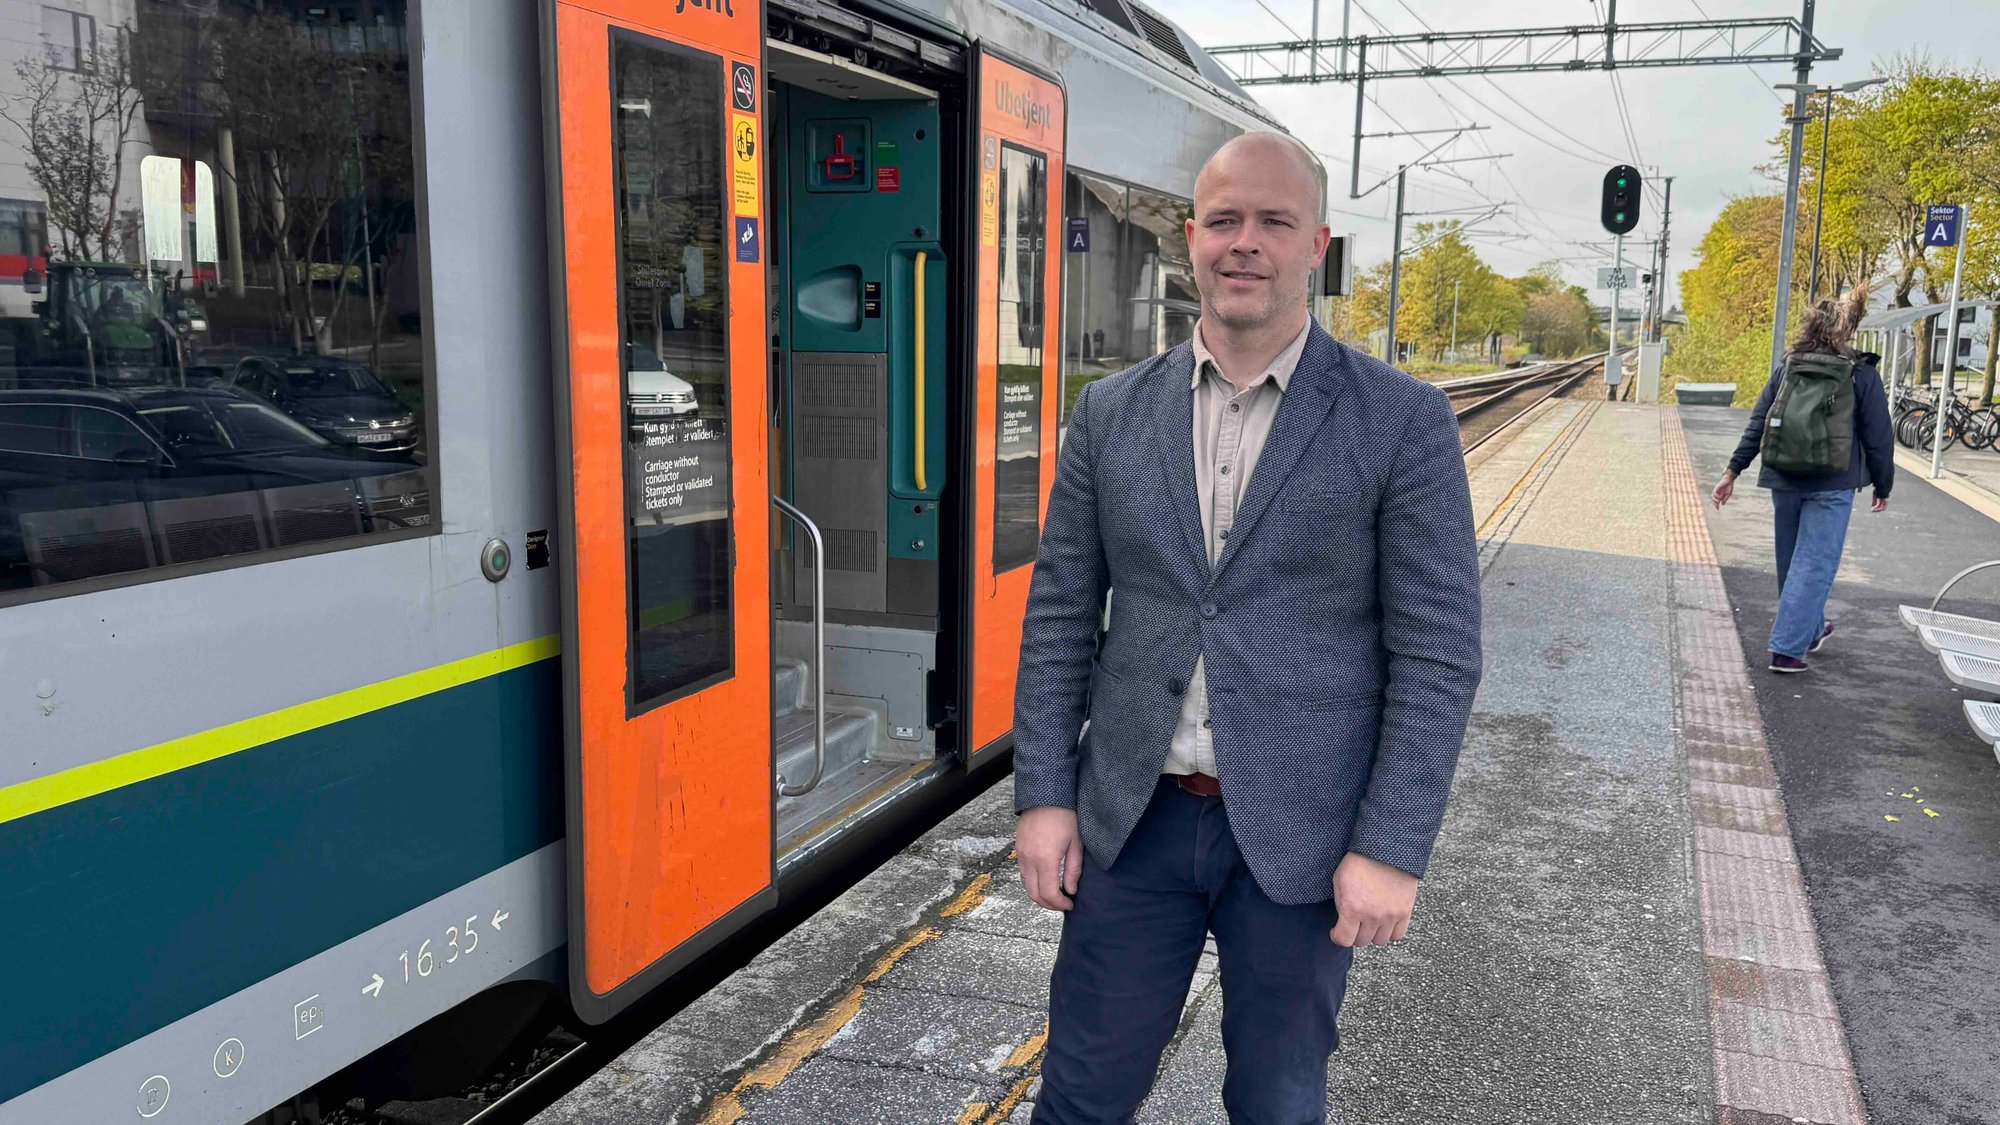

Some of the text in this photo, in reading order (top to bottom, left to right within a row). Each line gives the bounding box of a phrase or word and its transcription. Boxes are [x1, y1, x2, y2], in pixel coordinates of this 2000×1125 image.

[995, 79, 1052, 130] Ubetjent
[1930, 206, 1955, 214] Sektor
[1931, 223, 1947, 241] A
[644, 422, 659, 433] Kun
[644, 455, 699, 473] Carriage without
[645, 471, 680, 485] conductor
[645, 475, 713, 498] Stamped or validated
[645, 493, 683, 510] tickets only
[399, 915, 479, 987] 16.35
[224, 1049, 235, 1067] K
